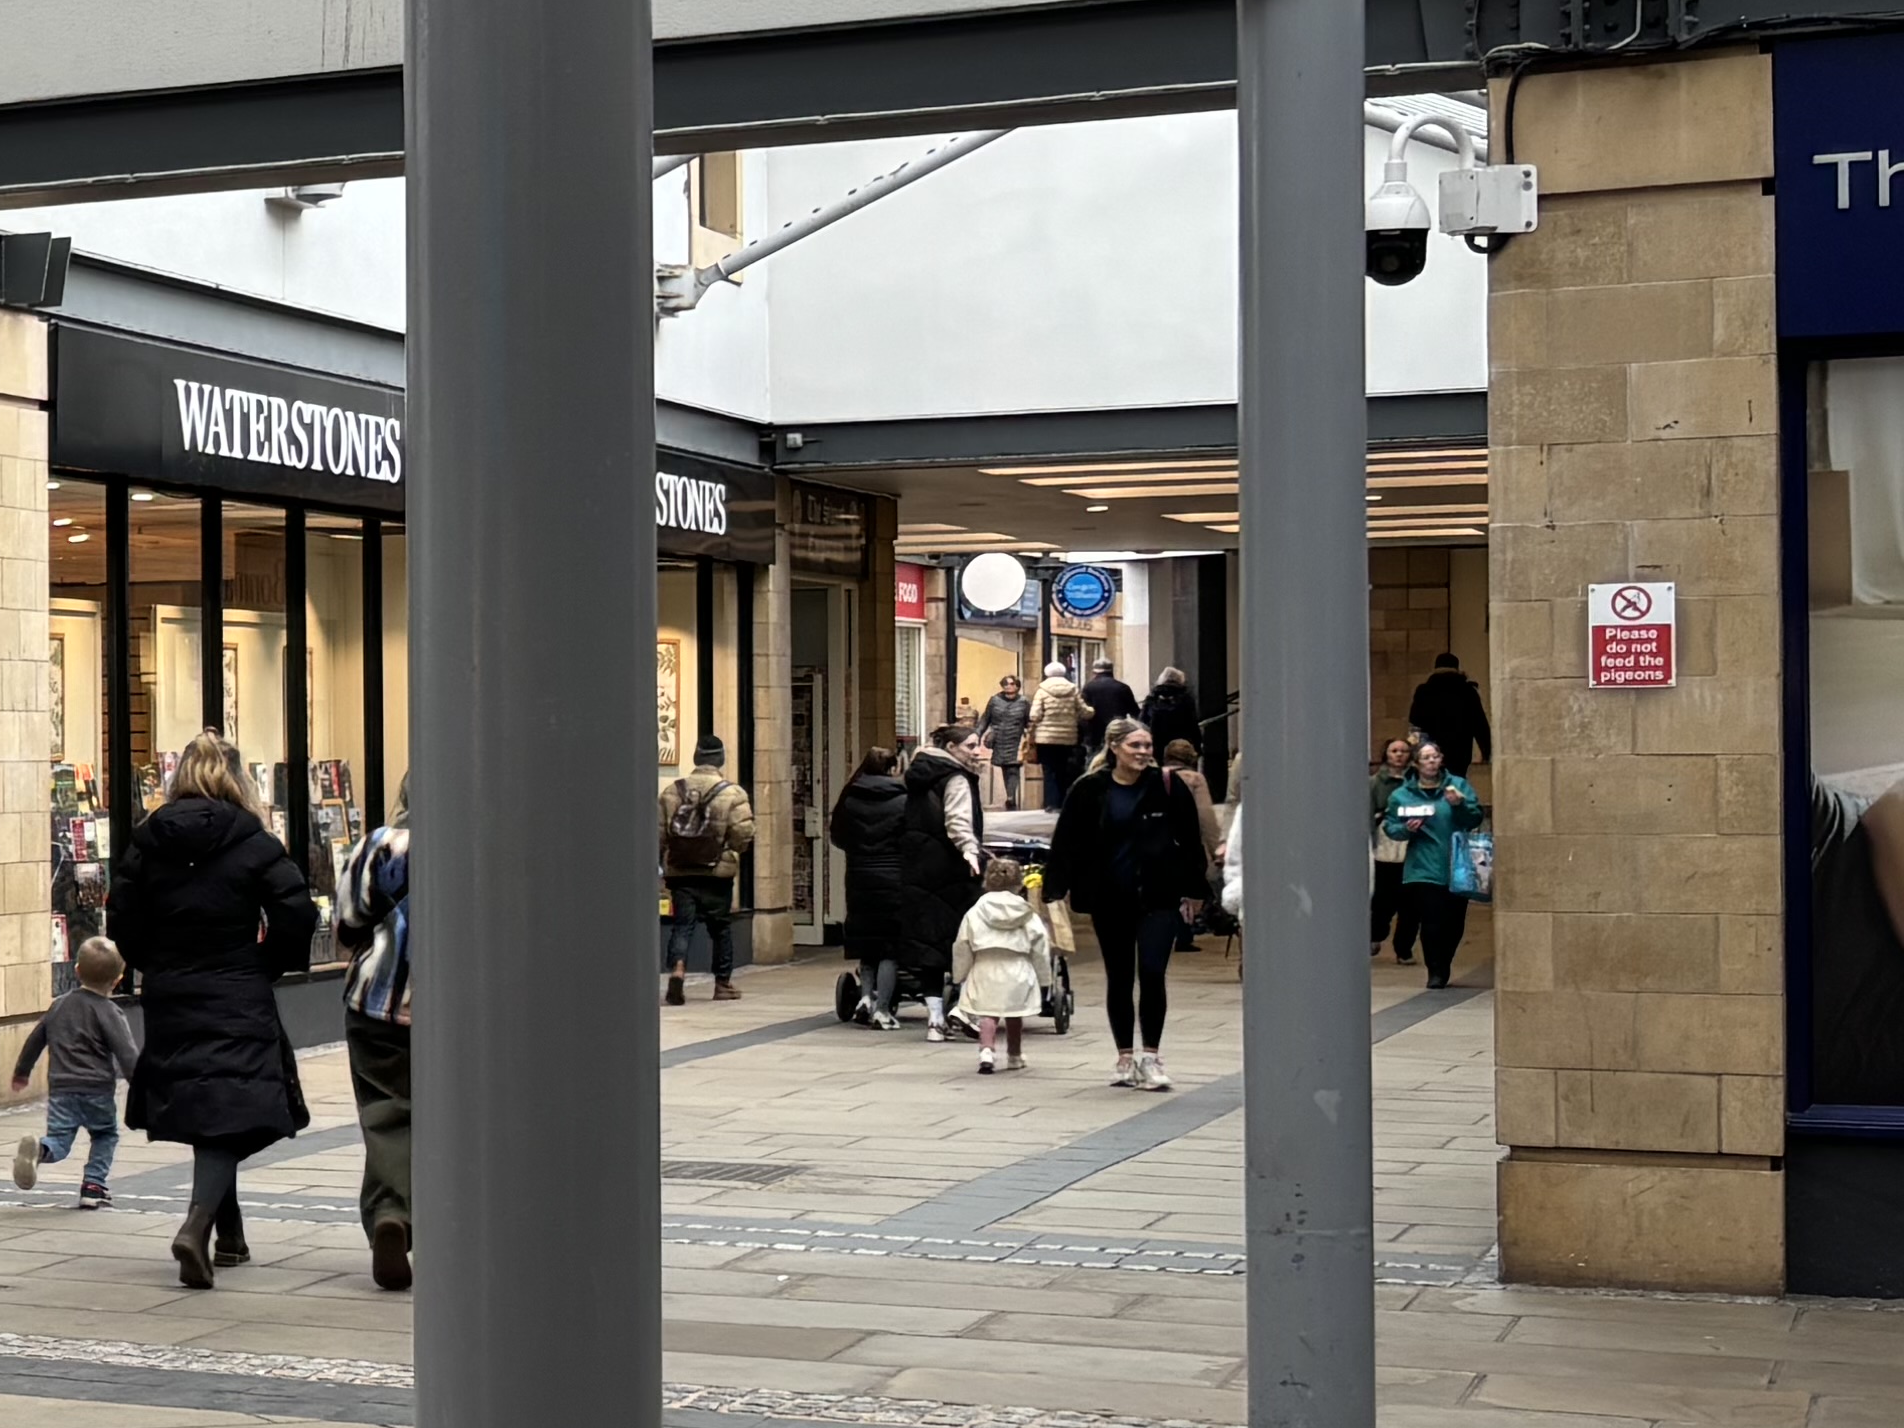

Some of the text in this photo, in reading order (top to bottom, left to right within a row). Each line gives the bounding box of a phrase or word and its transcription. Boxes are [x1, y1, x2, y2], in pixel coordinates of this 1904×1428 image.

[173, 378, 402, 484] WATERSTONES
[1605, 628, 1658, 640] Please
[1606, 641, 1657, 653] do not
[1600, 655, 1664, 667] feed the
[1600, 669, 1664, 683] pigeons
